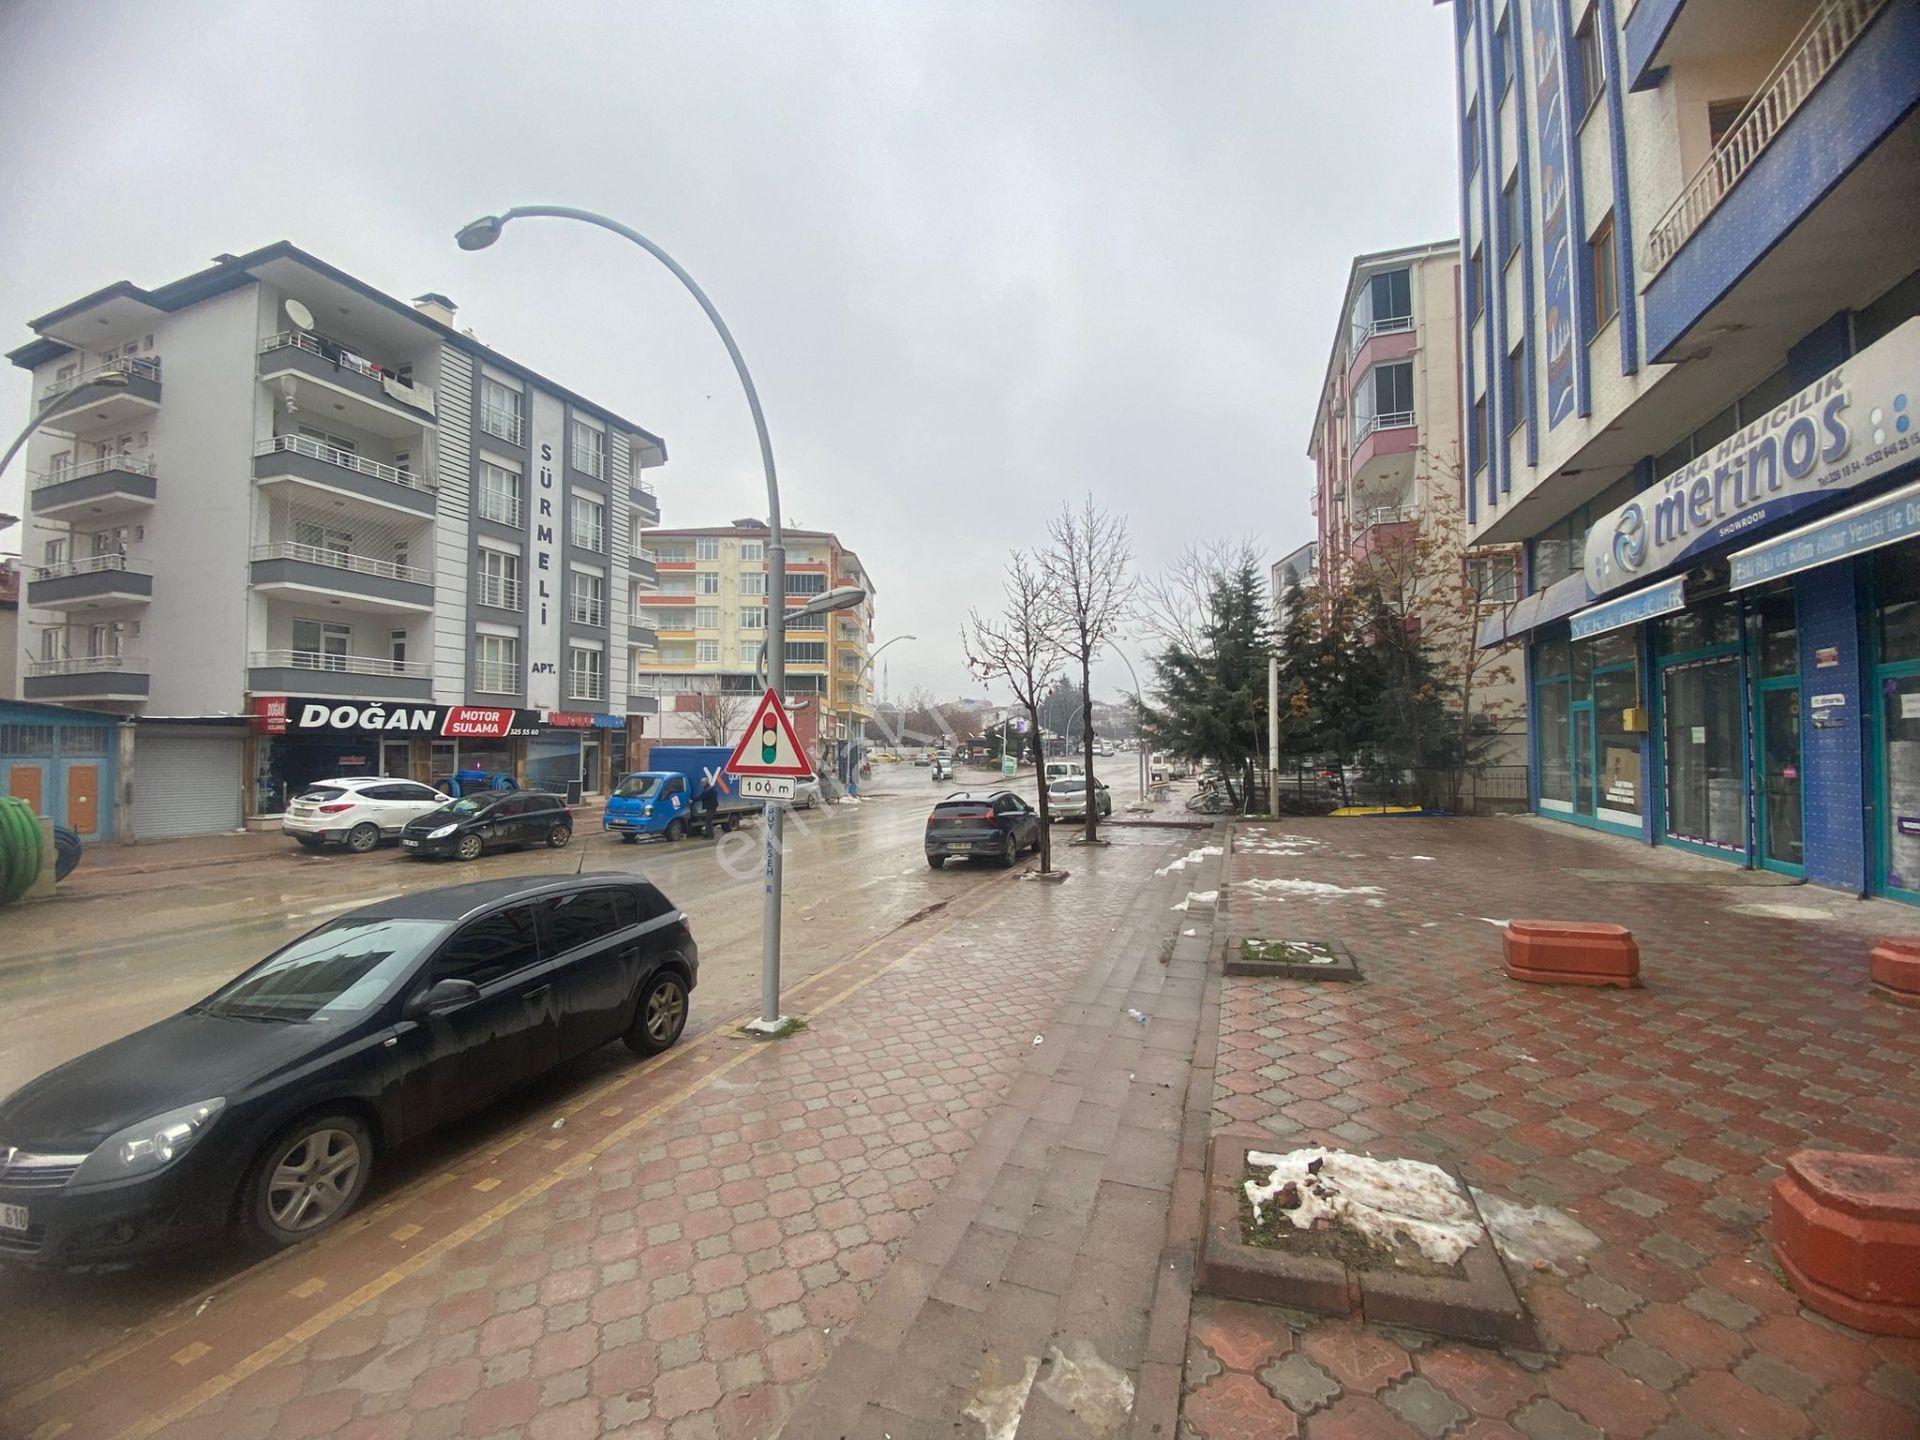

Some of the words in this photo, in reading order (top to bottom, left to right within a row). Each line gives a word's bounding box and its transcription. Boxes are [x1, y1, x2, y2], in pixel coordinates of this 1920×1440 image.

[1654, 391, 1850, 547] merinos
[1663, 459, 1710, 493] YEKA
[537, 443, 553, 625] SÜRMELİ
[1718, 509, 1767, 537] SHOWROOM
[531, 662, 556, 674] APT.
[299, 702, 436, 730] DOĞAN
[452, 722, 499, 733] SULAMA
[460, 710, 499, 722] MOTOR
[747, 782, 771, 792] 100
[778, 784, 789, 793] m
